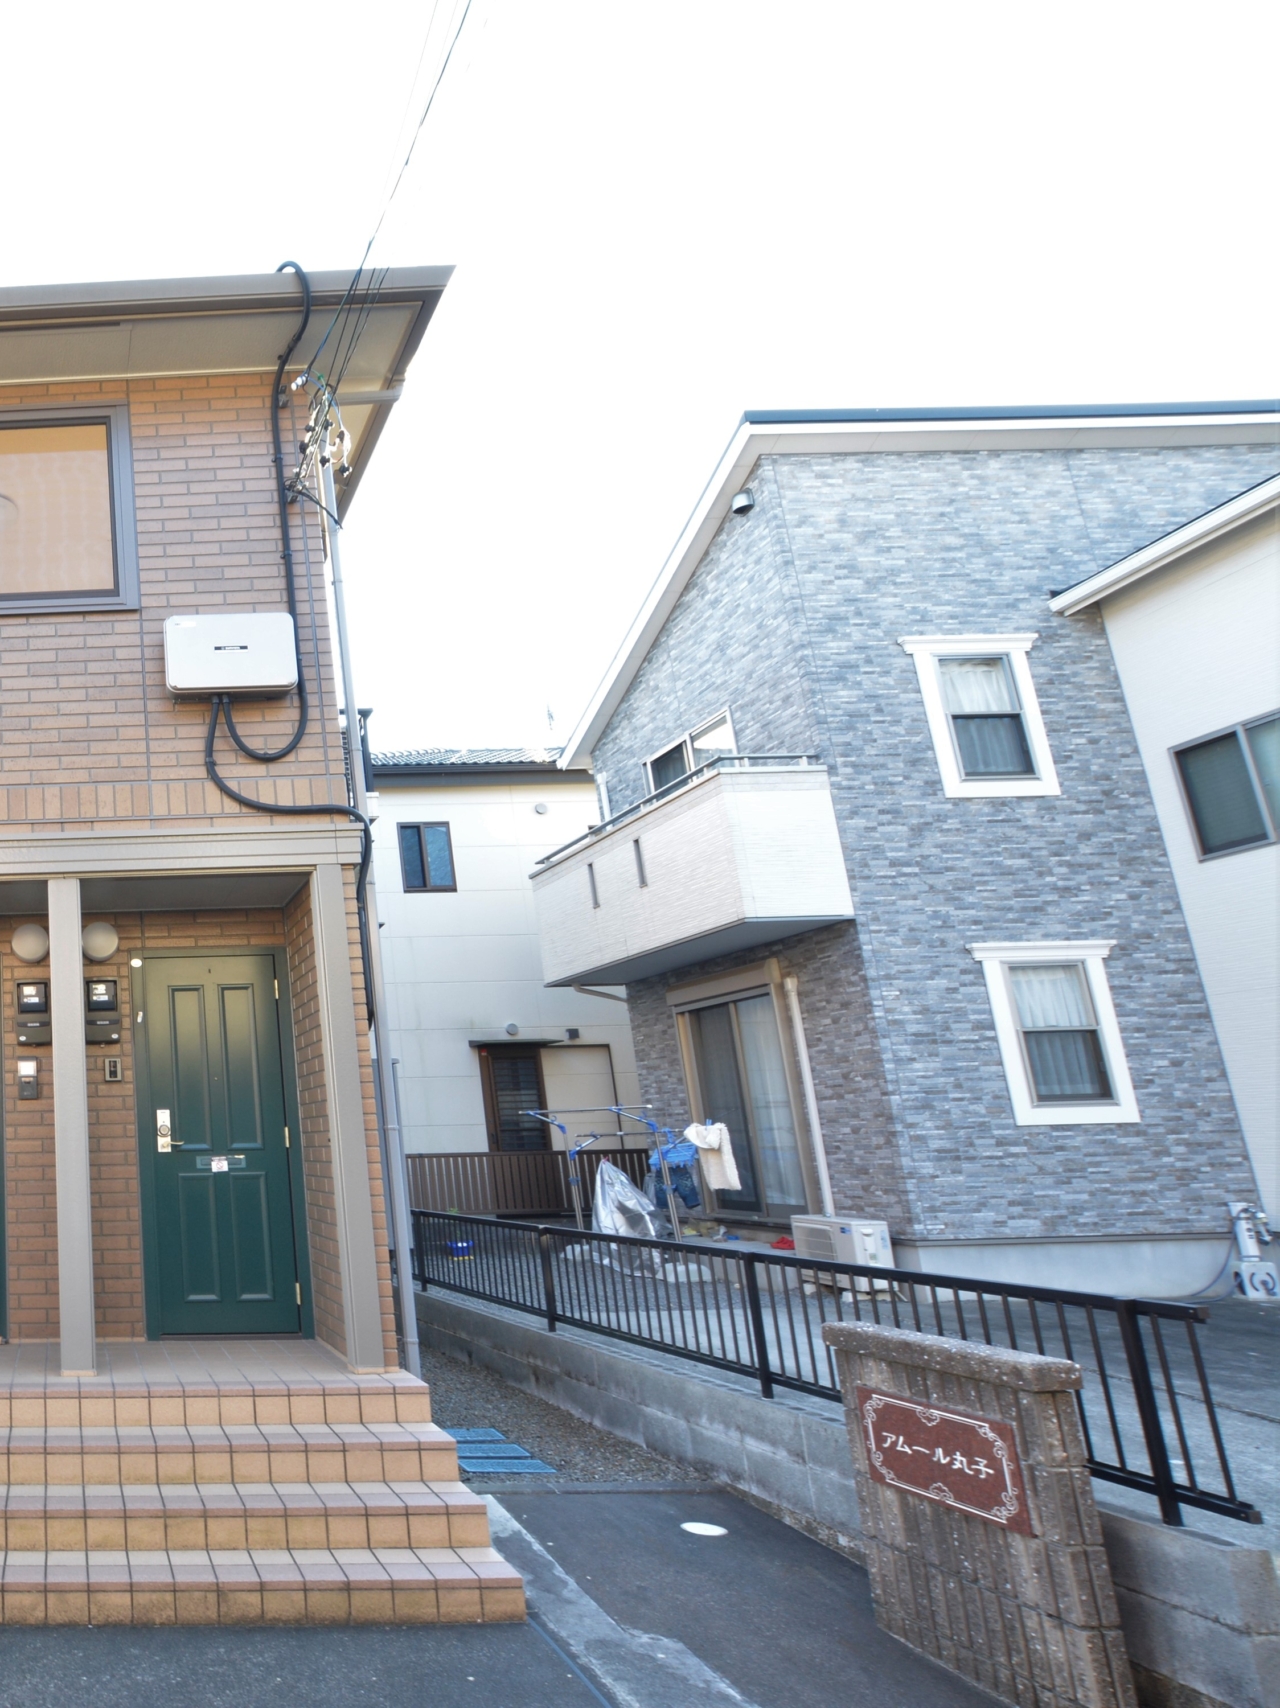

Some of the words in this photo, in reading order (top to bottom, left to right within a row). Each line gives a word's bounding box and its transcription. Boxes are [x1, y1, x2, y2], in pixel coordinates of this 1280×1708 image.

[882, 1432, 995, 1478] アムール丸子
